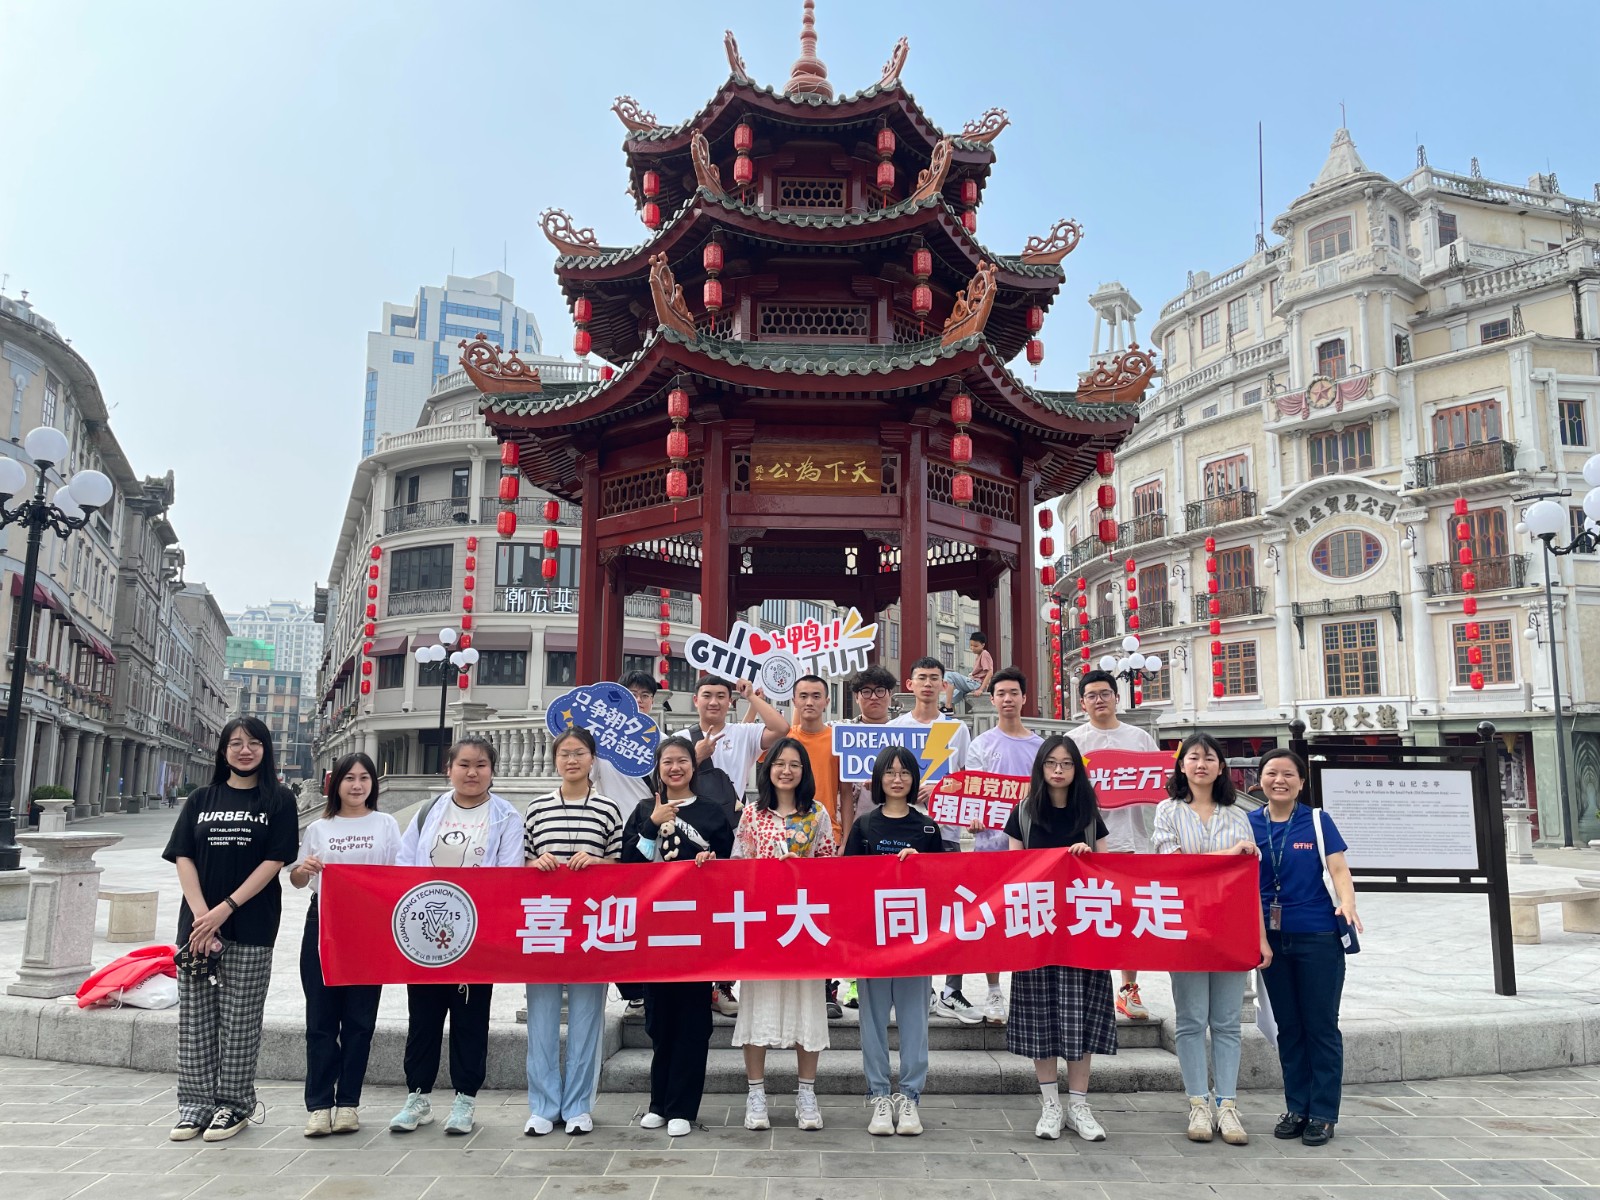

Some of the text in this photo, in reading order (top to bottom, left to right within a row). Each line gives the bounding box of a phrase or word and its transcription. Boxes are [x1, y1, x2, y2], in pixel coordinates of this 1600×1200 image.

[504, 587, 573, 614] 潮宏基
[734, 627, 746, 650] I
[691, 639, 763, 684] GTIIT
[796, 643, 872, 676] TIIT
[572, 691, 643, 735] 只争朝夕
[842, 731, 904, 749] DREAM
[932, 794, 1014, 828] 强国有
[330, 844, 346, 852] One
[515, 887, 832, 954] 喜迎二十大
[873, 877, 1189, 946] 同心跟党走
